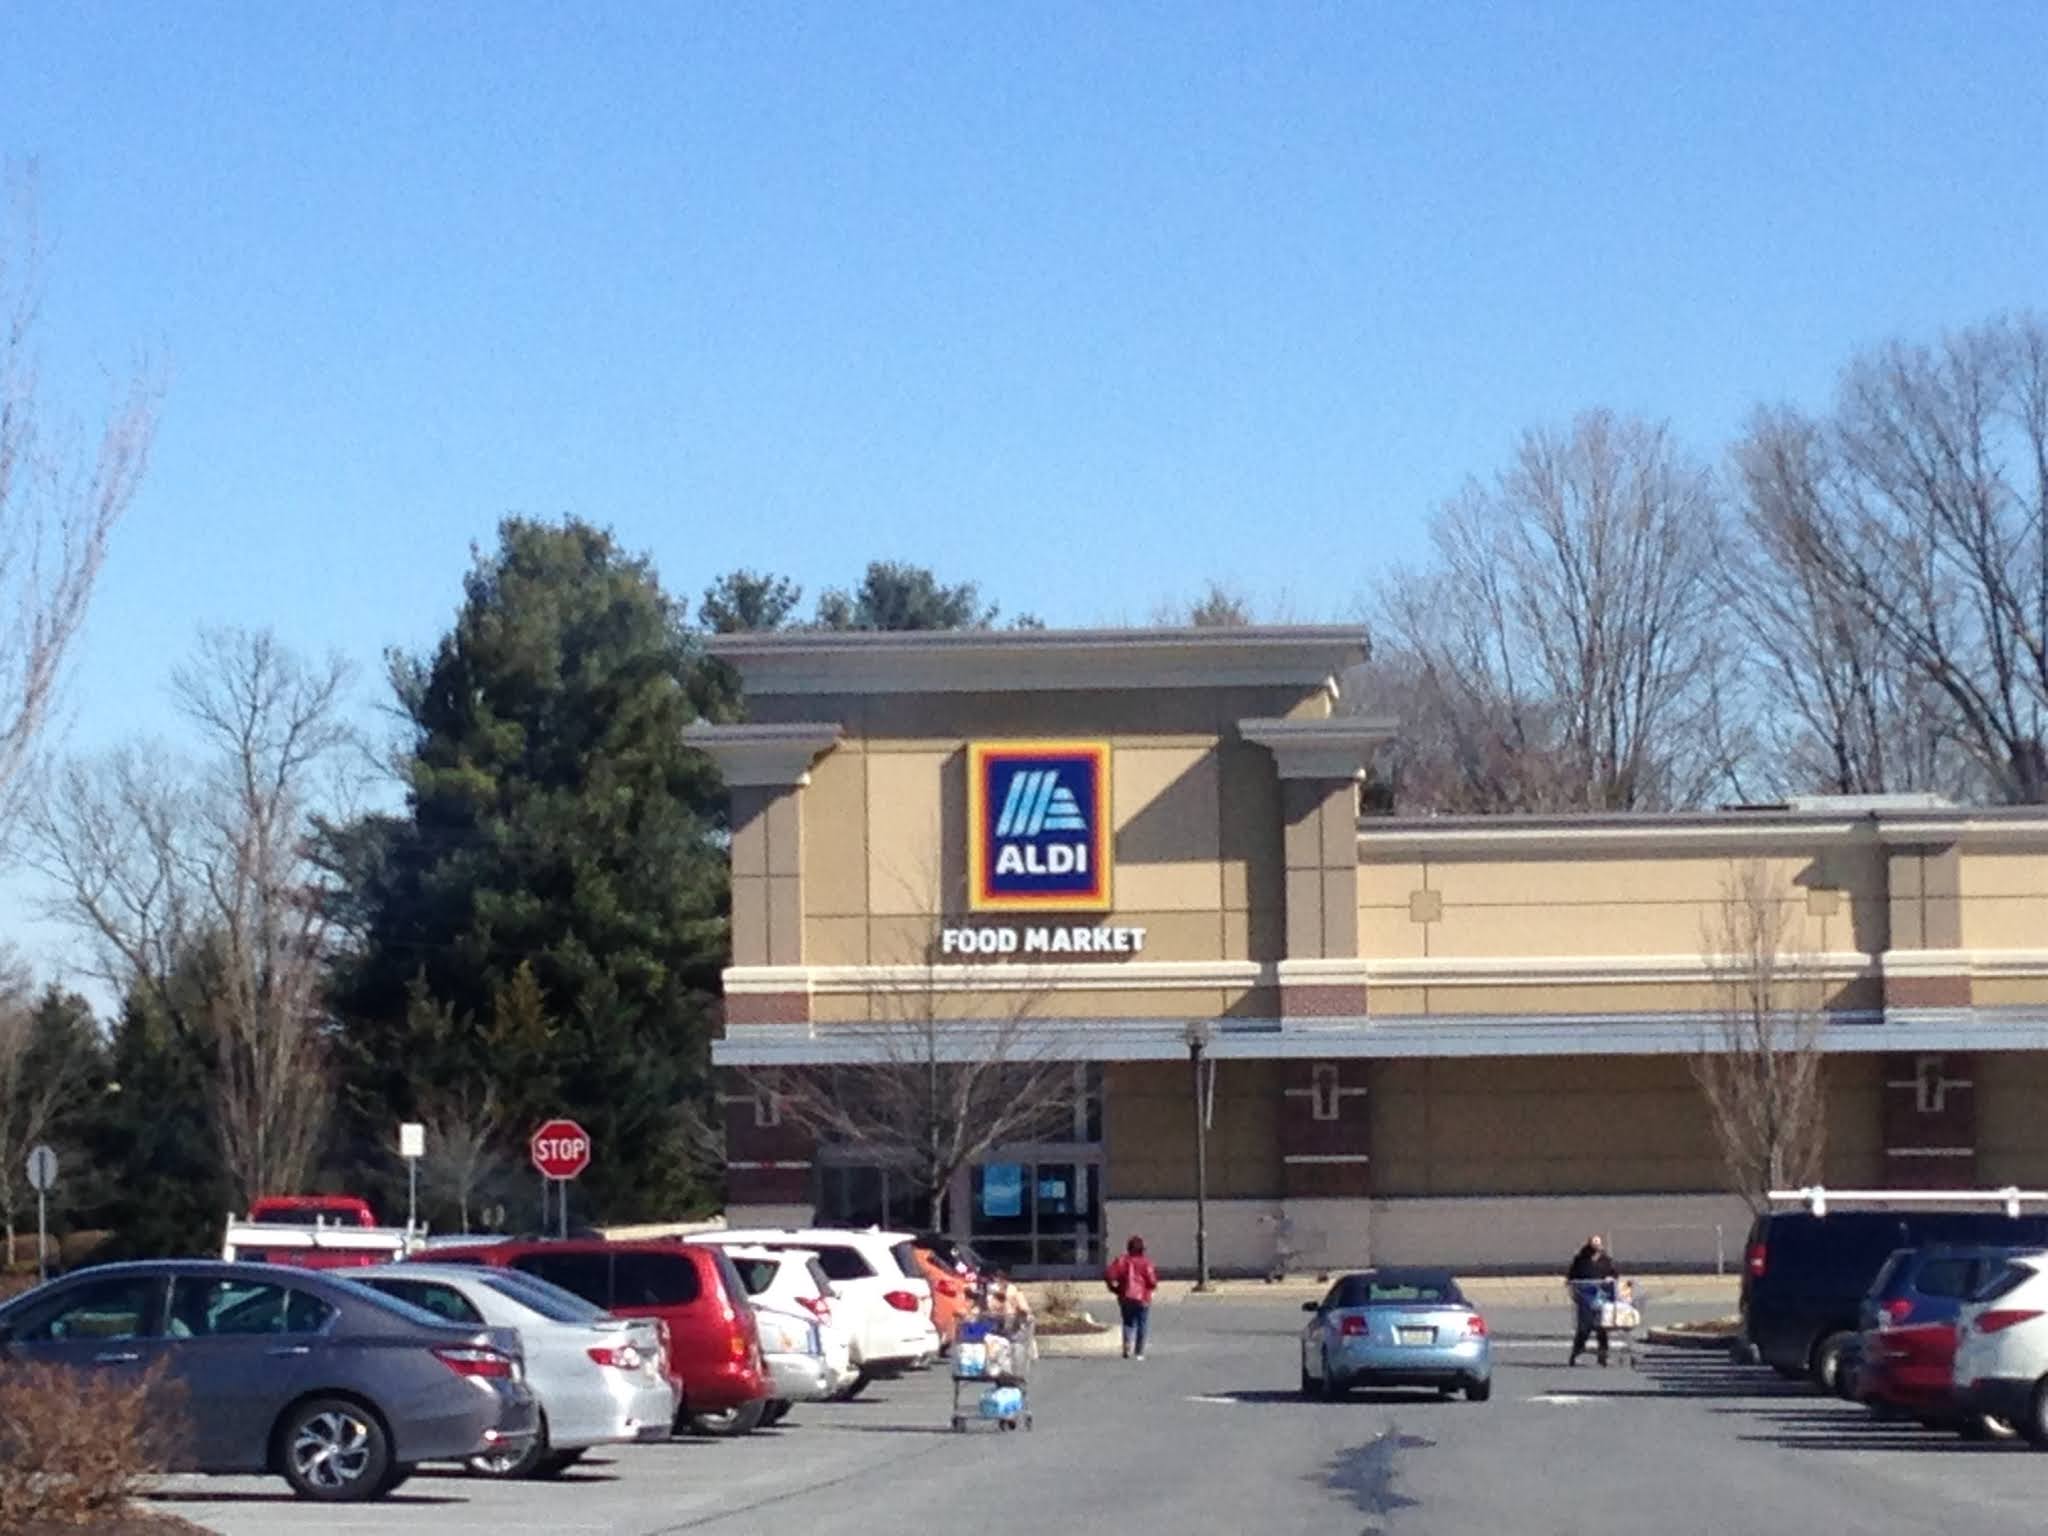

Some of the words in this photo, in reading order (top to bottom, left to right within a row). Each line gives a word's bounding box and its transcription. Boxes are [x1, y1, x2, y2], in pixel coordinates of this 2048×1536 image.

[996, 843, 1088, 874] ALDI
[942, 928, 1018, 953] FOOD
[1024, 927, 1147, 952] MARKET
[536, 1138, 585, 1160] STOP
